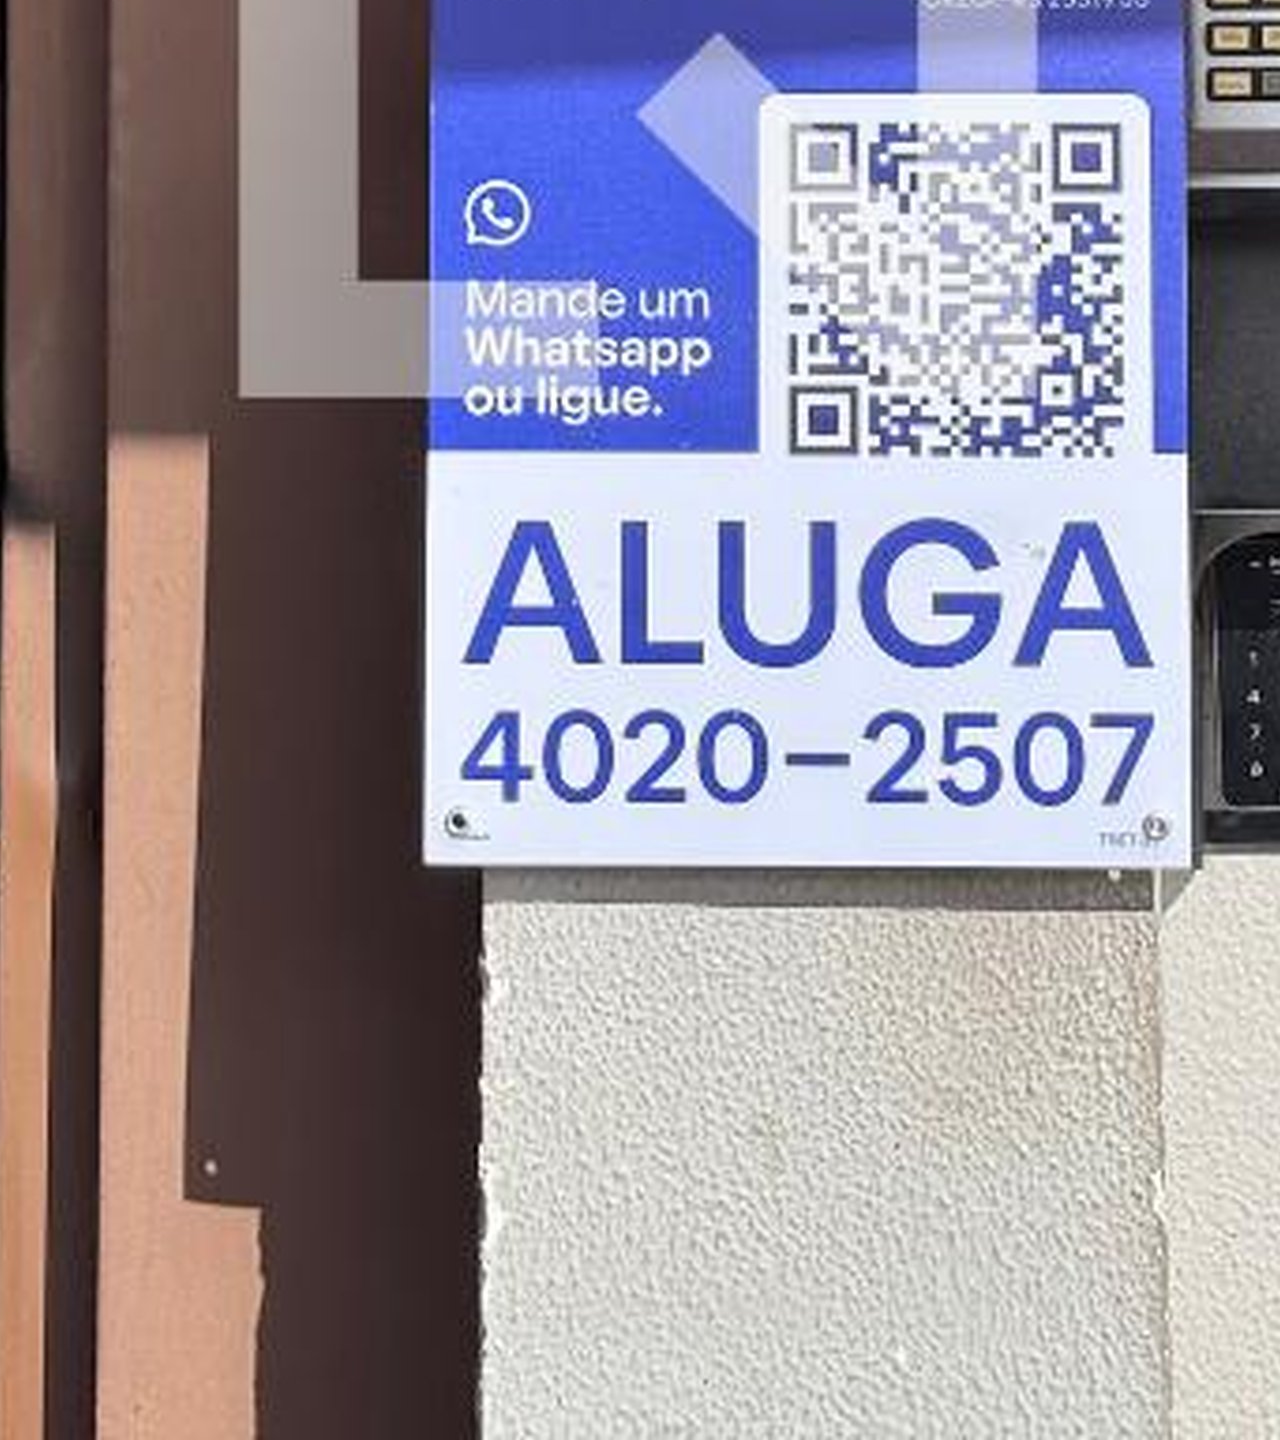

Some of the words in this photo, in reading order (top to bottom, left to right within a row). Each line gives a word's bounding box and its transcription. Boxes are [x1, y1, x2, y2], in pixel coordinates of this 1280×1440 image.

[465, 279, 628, 320] Mande
[638, 289, 711, 320] um
[465, 326, 712, 376] Whatsapp
[464, 385, 523, 417] ou
[537, 375, 664, 426] ligue.
[461, 518, 1154, 668] ALUGA
[460, 709, 1155, 806] 4020-2507
